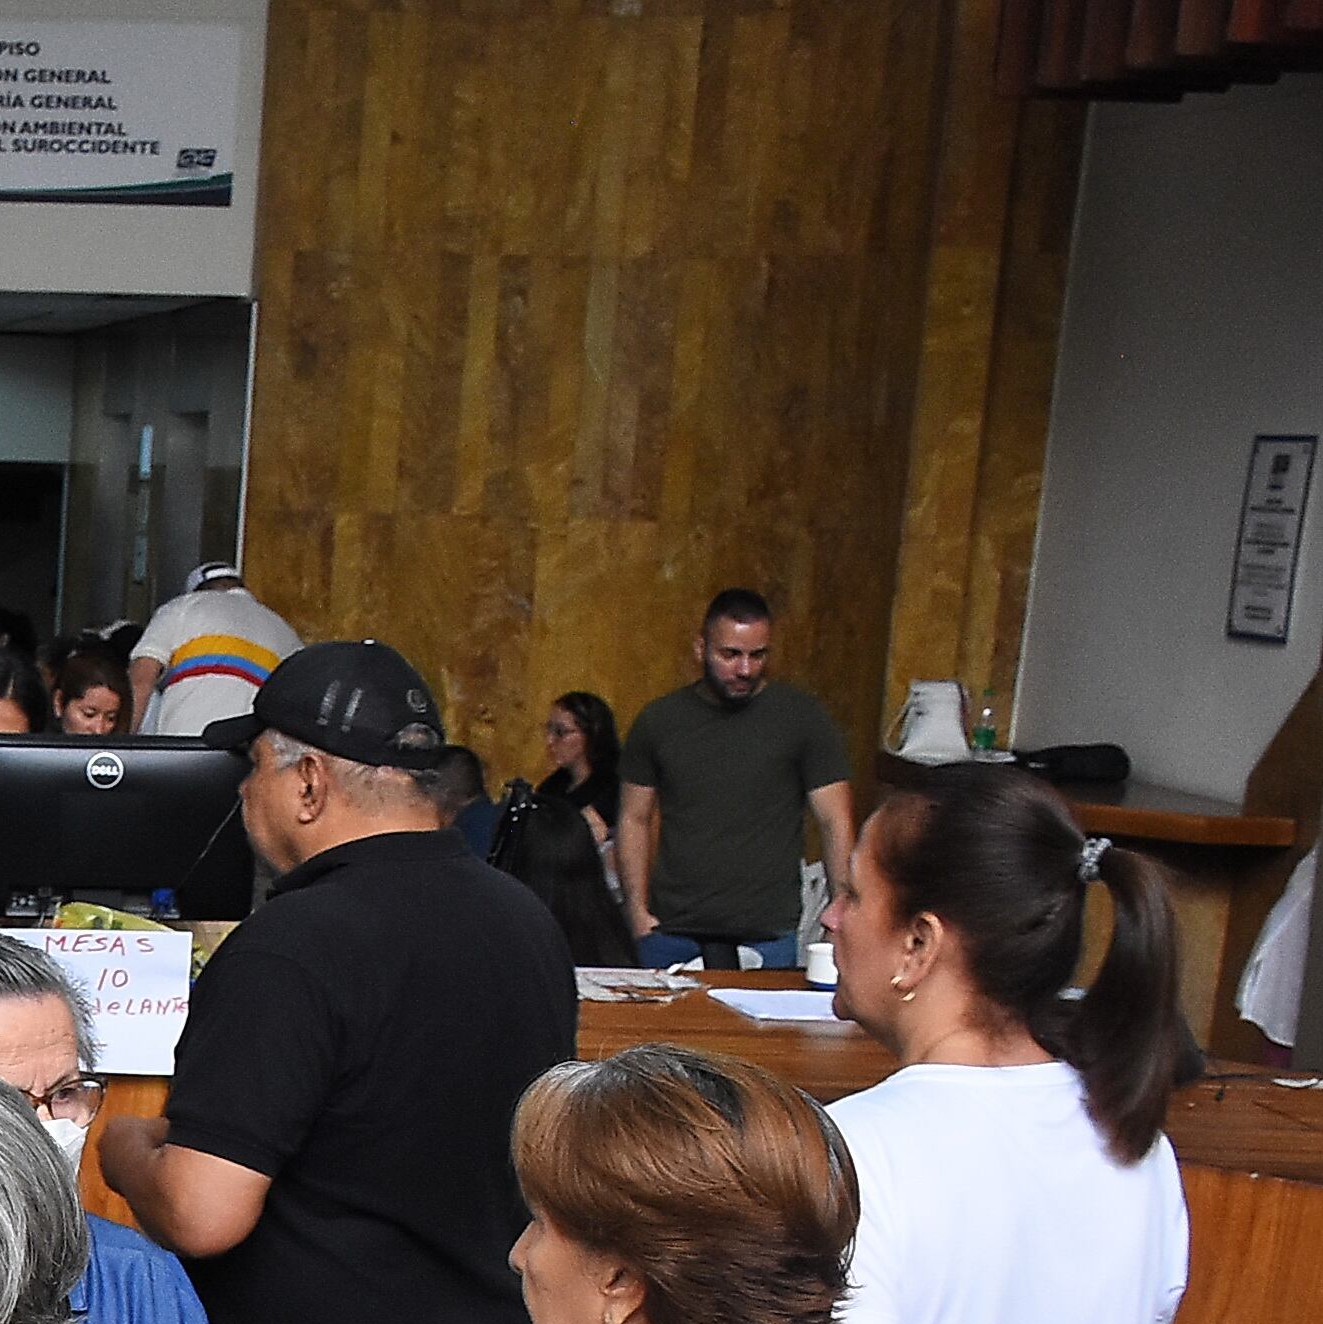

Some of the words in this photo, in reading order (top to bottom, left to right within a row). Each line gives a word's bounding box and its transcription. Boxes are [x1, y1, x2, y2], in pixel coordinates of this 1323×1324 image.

[24, 69, 111, 84] GENERAL
[30, 95, 117, 110] GENERAL
[19, 122, 126, 136] AMBIENTAL
[12, 139, 159, 155] SUROCCIDENTE
[91, 764, 119, 776] DELL
[97, 968, 129, 991] 10
